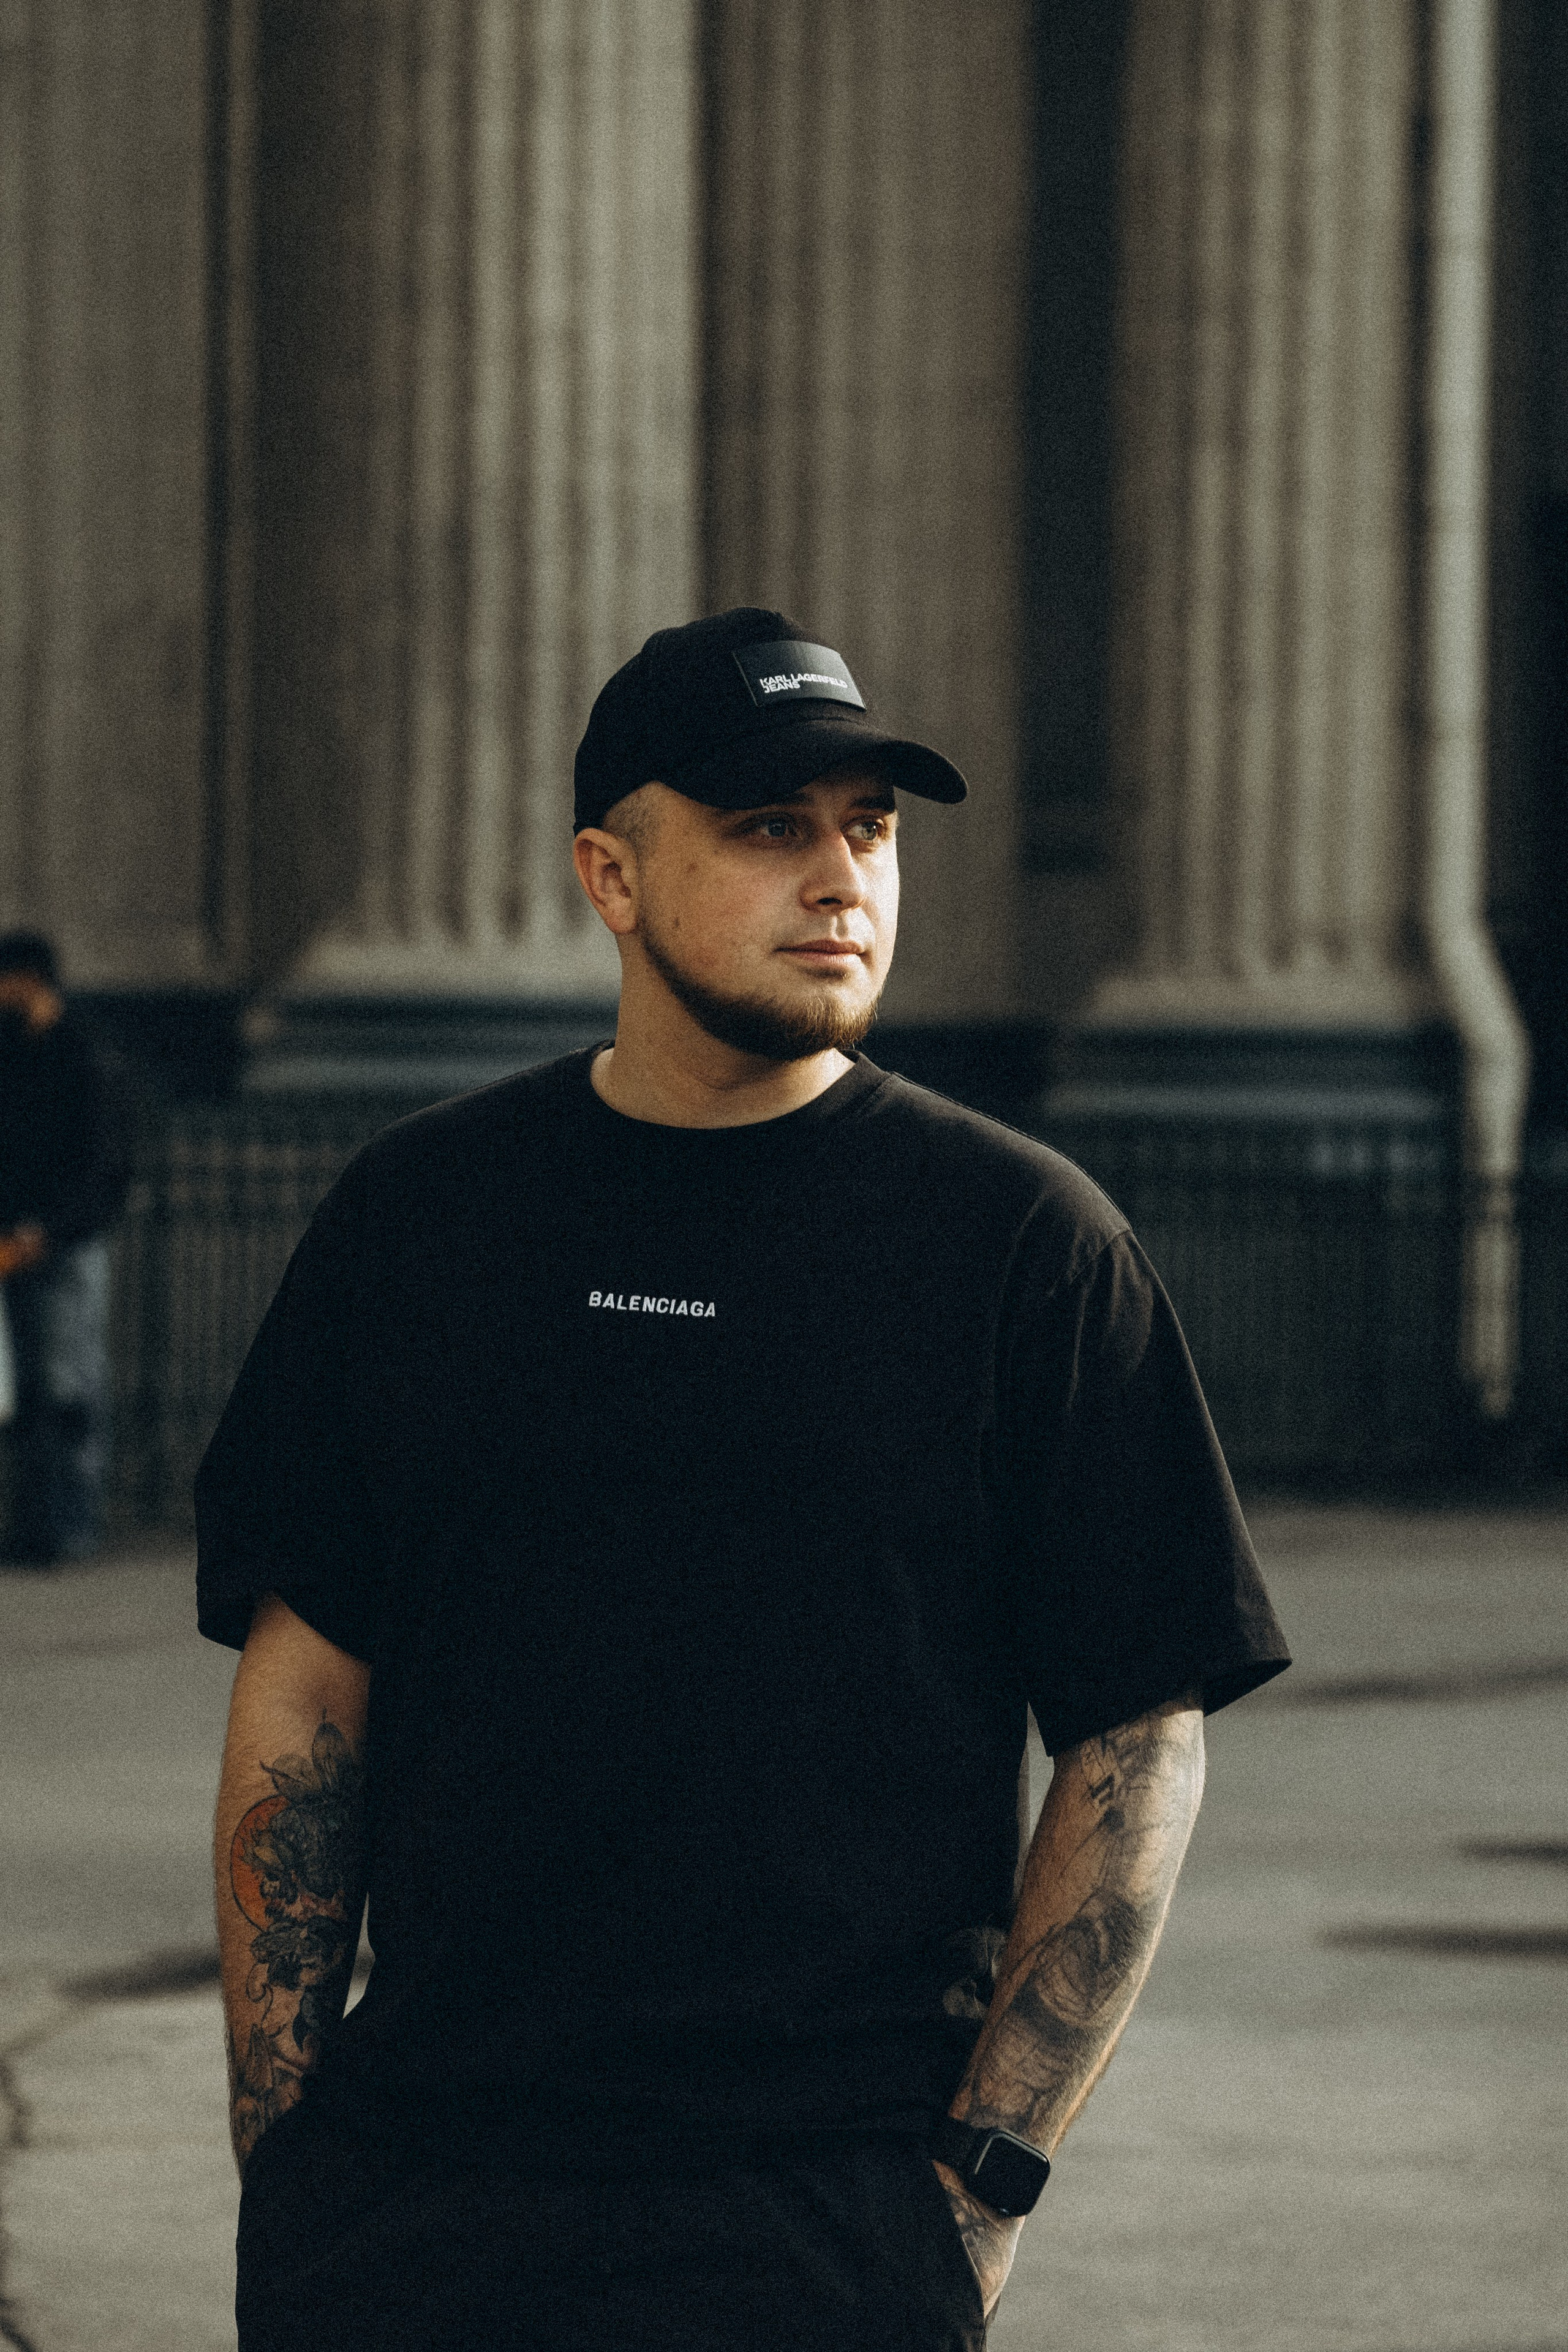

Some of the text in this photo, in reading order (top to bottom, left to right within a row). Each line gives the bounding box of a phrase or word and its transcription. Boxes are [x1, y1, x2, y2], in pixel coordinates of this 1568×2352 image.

[760, 673, 848, 688] KARL LAGERFELD
[763, 681, 801, 693] JEANS
[589, 1291, 715, 1317] BALENCIAGA
